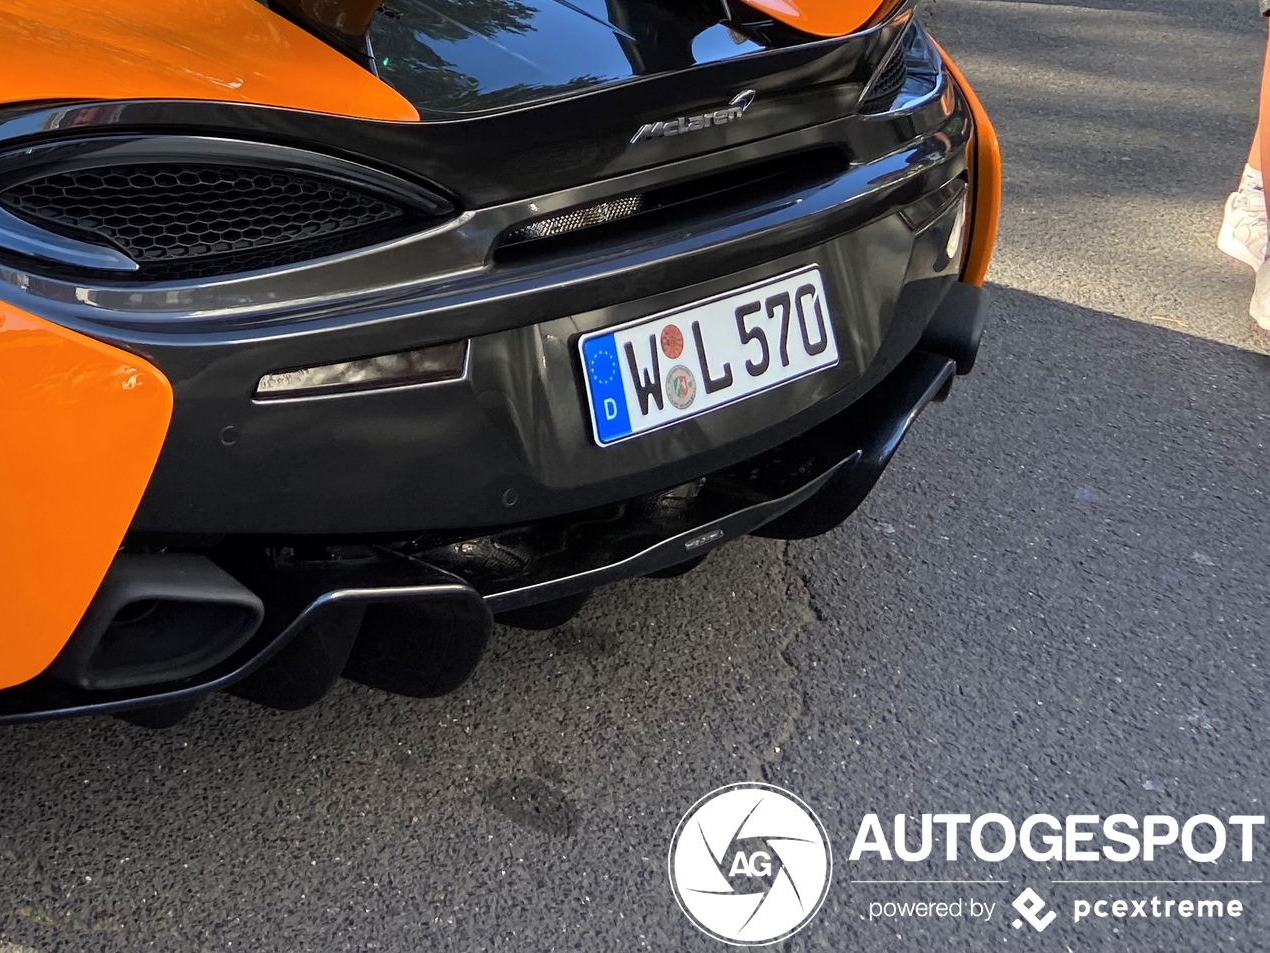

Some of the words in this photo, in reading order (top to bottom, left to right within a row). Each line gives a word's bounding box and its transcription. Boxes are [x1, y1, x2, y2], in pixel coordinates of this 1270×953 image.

[630, 105, 744, 145] McLaren
[623, 333, 664, 416] W
[691, 320, 734, 395] L
[734, 283, 828, 377] 570
[604, 397, 618, 421] D
